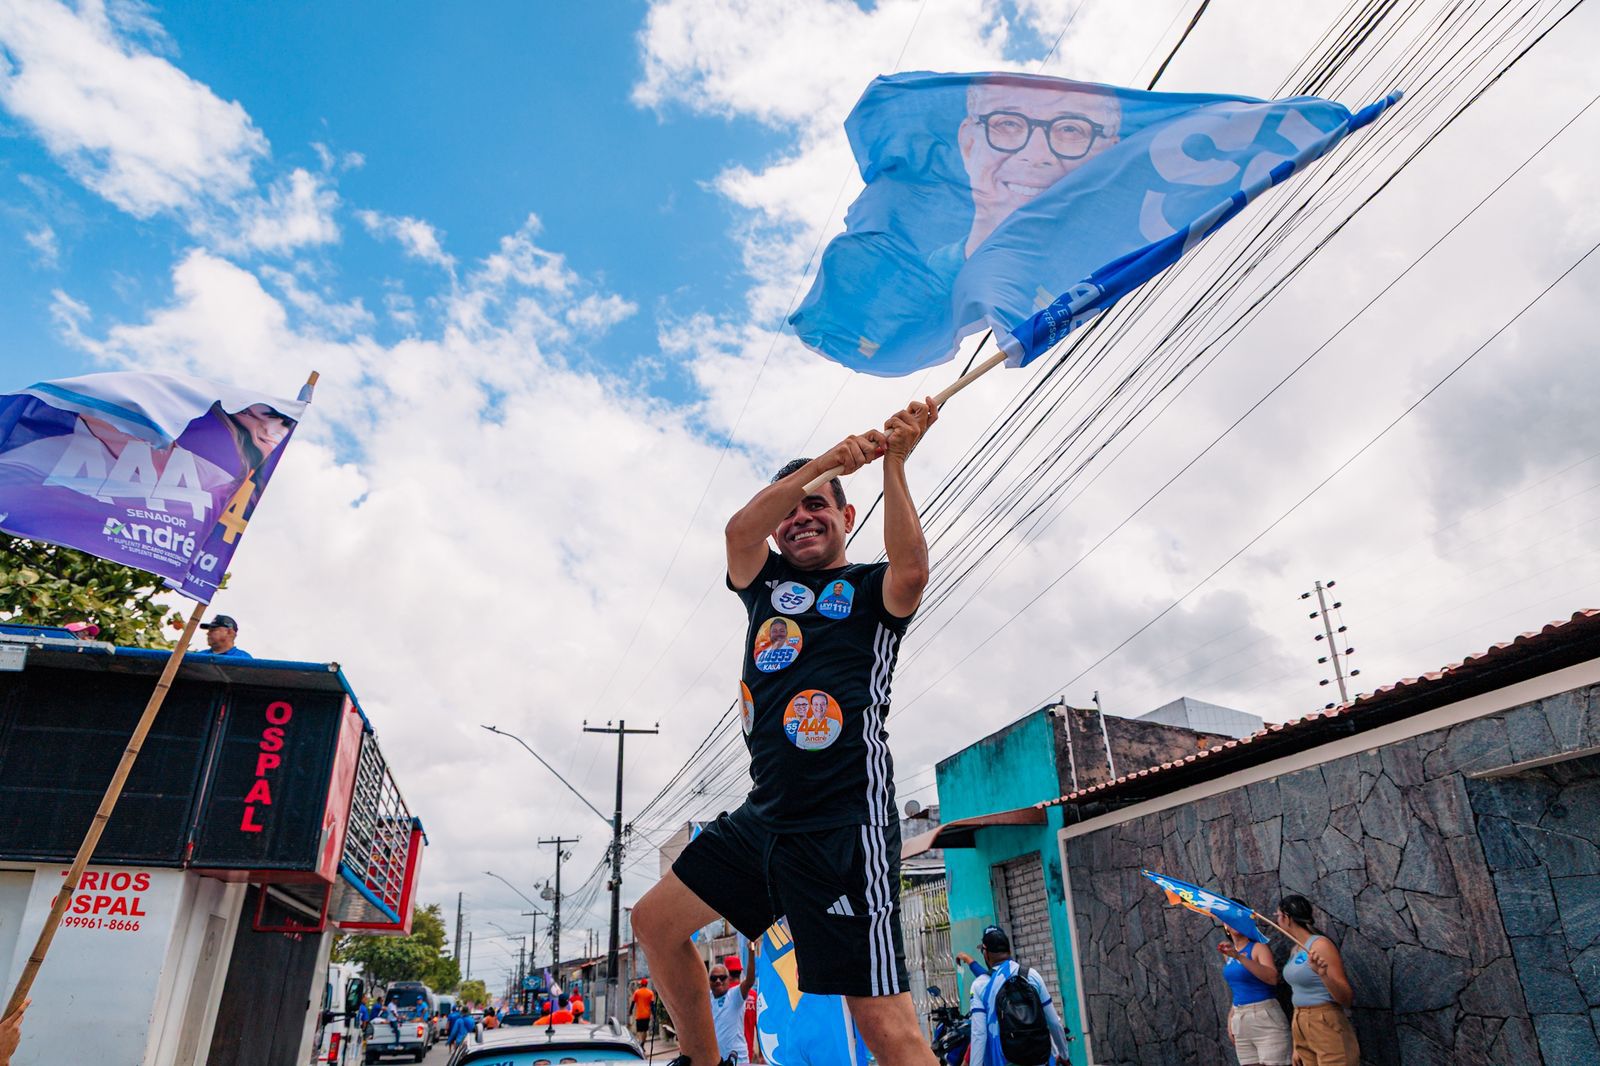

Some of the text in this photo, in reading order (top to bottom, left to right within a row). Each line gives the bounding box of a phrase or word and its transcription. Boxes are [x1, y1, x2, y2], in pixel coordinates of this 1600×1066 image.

[126, 508, 187, 528] SENADOR
[102, 517, 196, 558] André
[779, 592, 806, 606] 55
[797, 718, 831, 736] 444
[240, 701, 293, 833] OSPAL
[61, 870, 151, 893] RIOS
